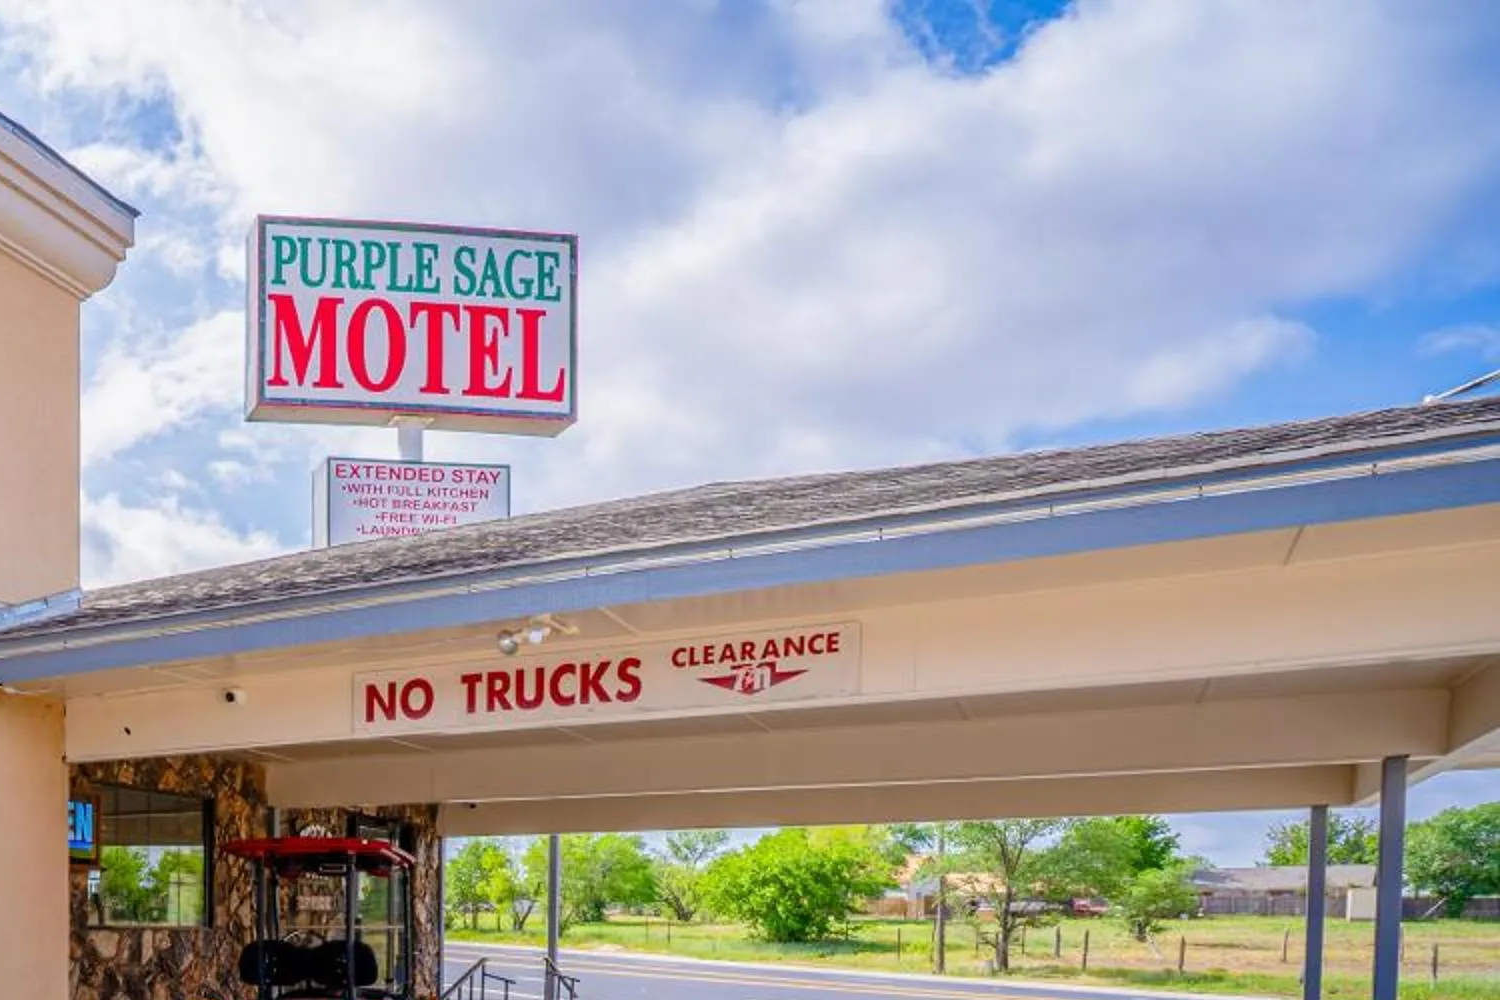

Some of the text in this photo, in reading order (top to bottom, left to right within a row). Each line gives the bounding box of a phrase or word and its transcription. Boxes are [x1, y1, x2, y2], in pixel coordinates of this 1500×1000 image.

[271, 235, 561, 302] PURPLE SAGE
[267, 293, 565, 402] MOTEL
[335, 463, 501, 485] EXTENDED STAY
[387, 485, 422, 497] FULL
[427, 487, 489, 500] KITCHEN
[392, 499, 479, 512] BREAKFAST
[671, 632, 840, 667] CLEARANCE
[365, 657, 642, 723] NO TRUCKS
